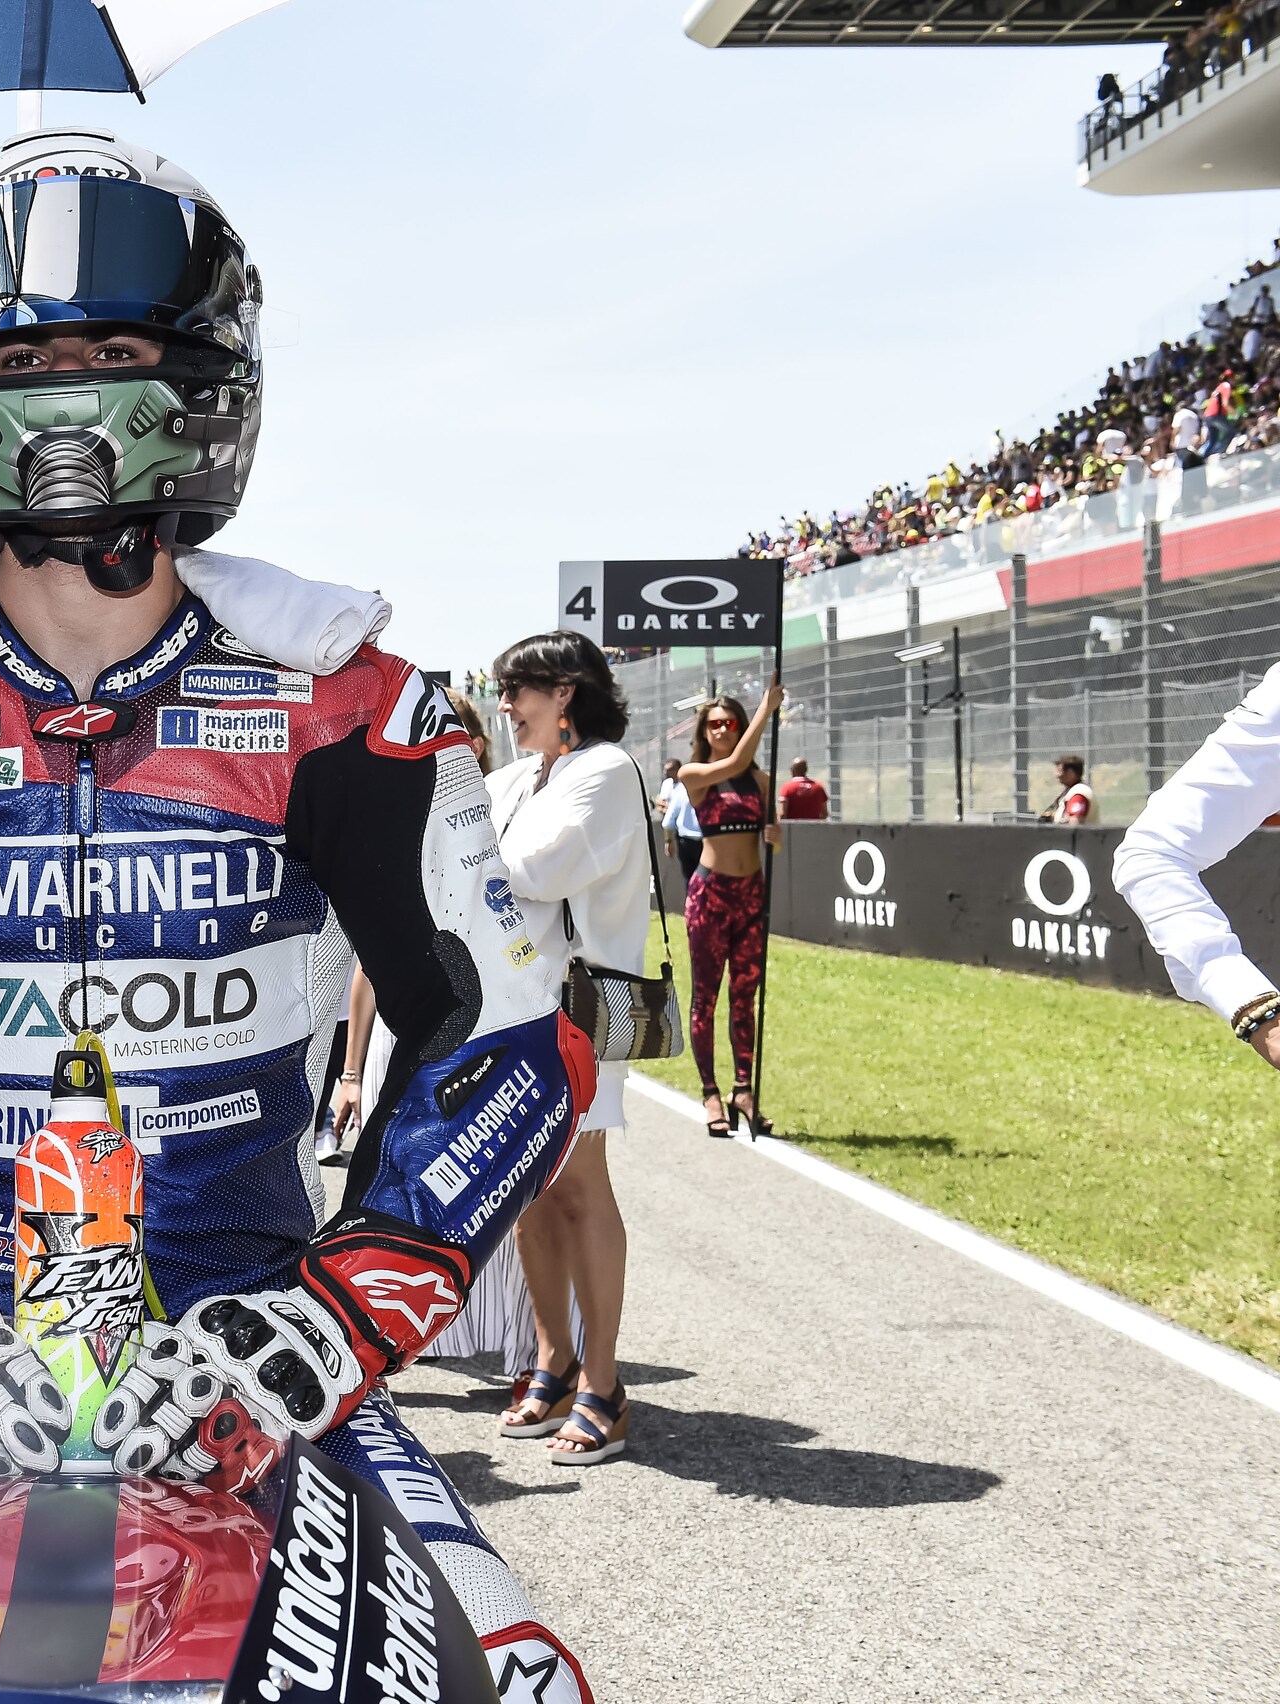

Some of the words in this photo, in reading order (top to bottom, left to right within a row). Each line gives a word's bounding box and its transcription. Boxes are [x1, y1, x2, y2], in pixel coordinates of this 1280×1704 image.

[565, 586, 596, 621] 4
[617, 613, 762, 631] OAKLEY
[104, 609, 199, 694] alpinestars
[188, 672, 261, 692] MARINELLI
[204, 711, 285, 731] marinelli
[204, 731, 285, 750] cucine
[834, 896, 897, 927] OAKLEY
[1011, 918, 1111, 959] OAKLEY
[114, 1037, 209, 1059] MASTERING
[213, 1028, 256, 1050] COLD
[142, 1094, 257, 1131] components
[448, 1060, 538, 1164] MARINELLI
[469, 1086, 541, 1176] cucine
[463, 1096, 570, 1238] unicomstarker
[266, 1455, 347, 1691] unicom
[365, 1526, 438, 1704] tarker
